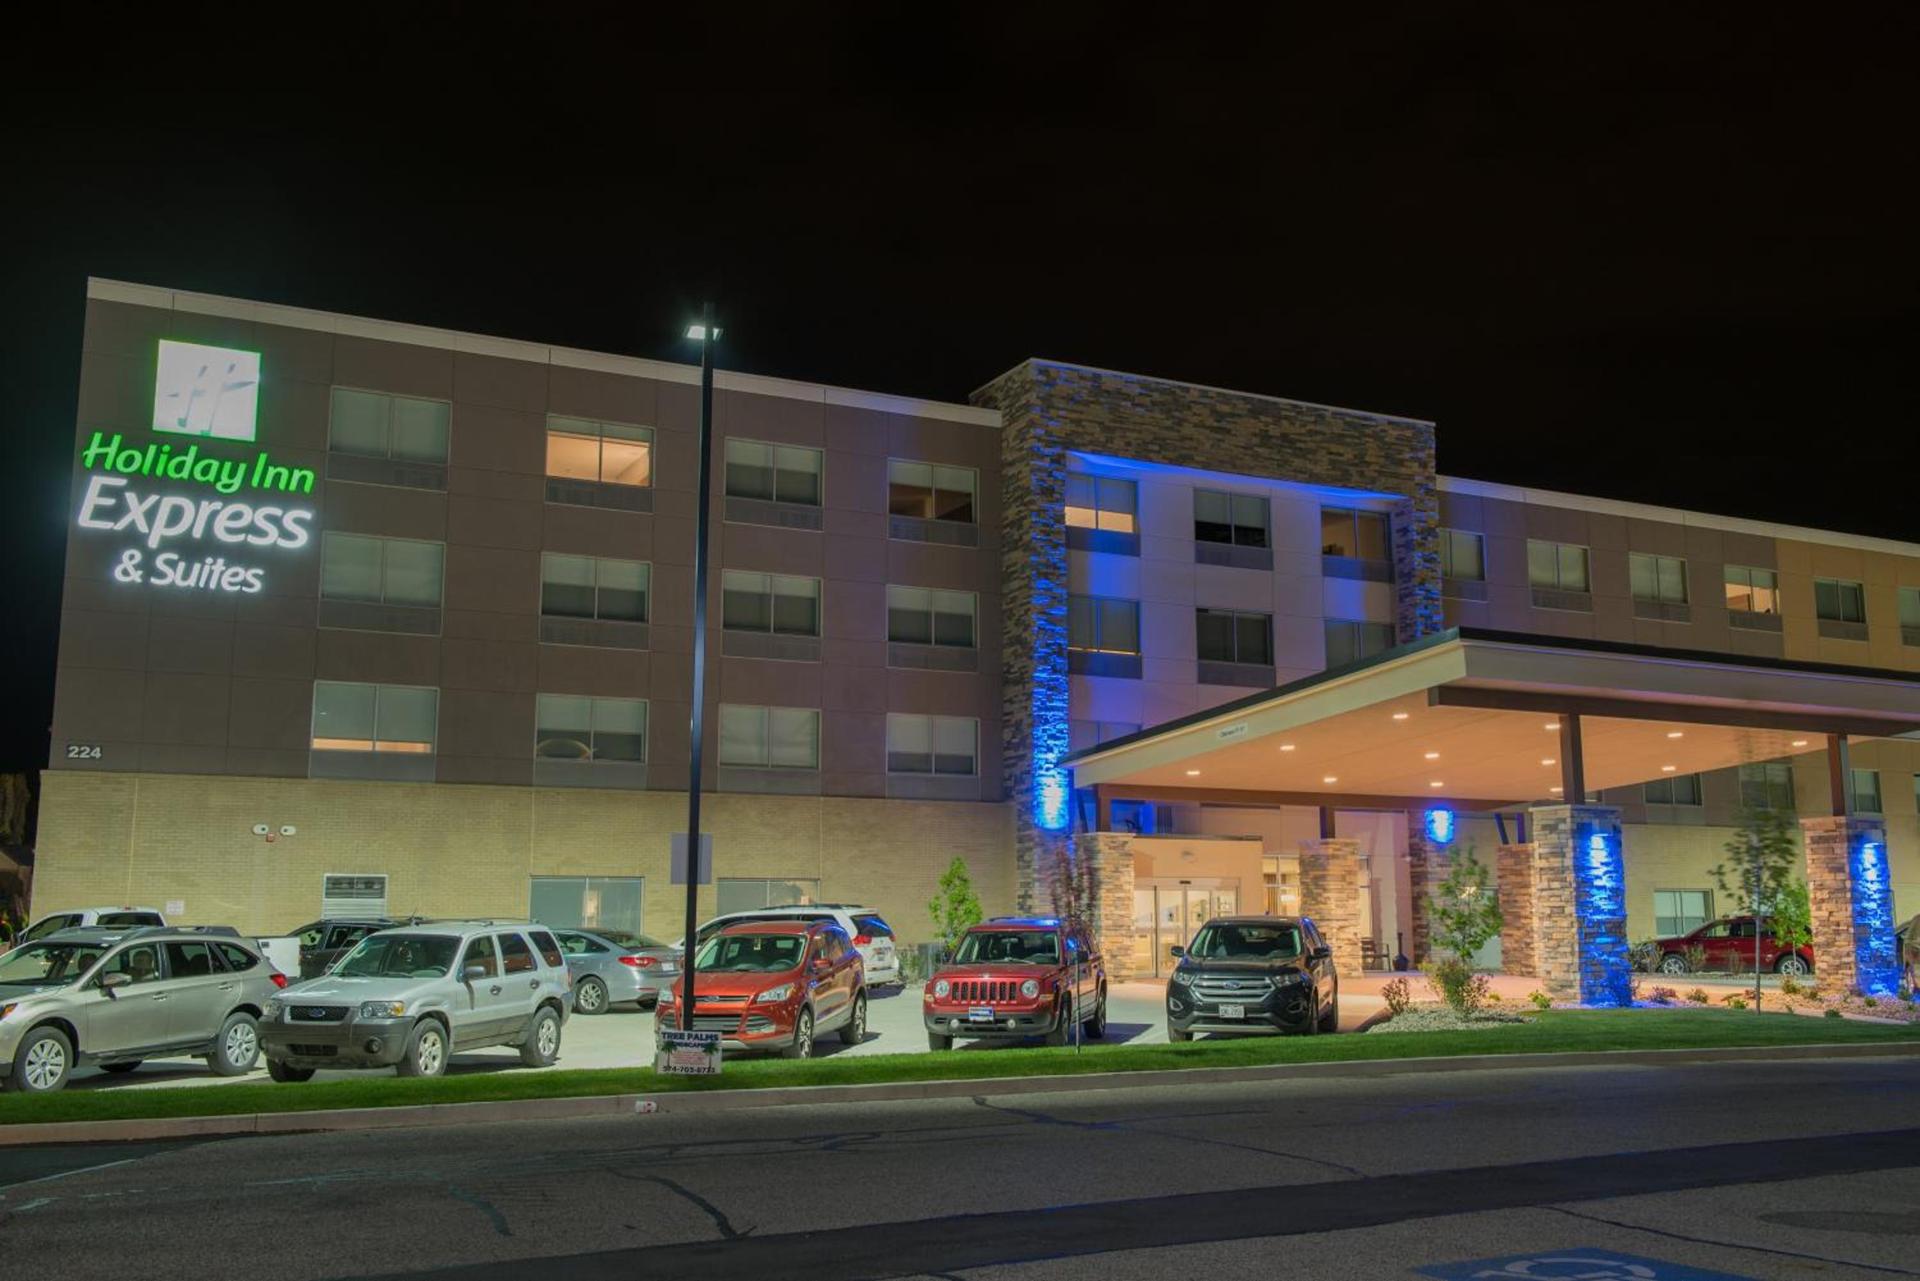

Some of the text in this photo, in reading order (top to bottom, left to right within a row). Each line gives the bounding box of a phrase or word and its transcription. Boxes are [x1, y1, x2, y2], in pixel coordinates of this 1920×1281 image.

[82, 432, 316, 494] Holiday Inn
[77, 475, 313, 550] Express
[113, 549, 265, 594] & Suites
[68, 745, 102, 759] 224
